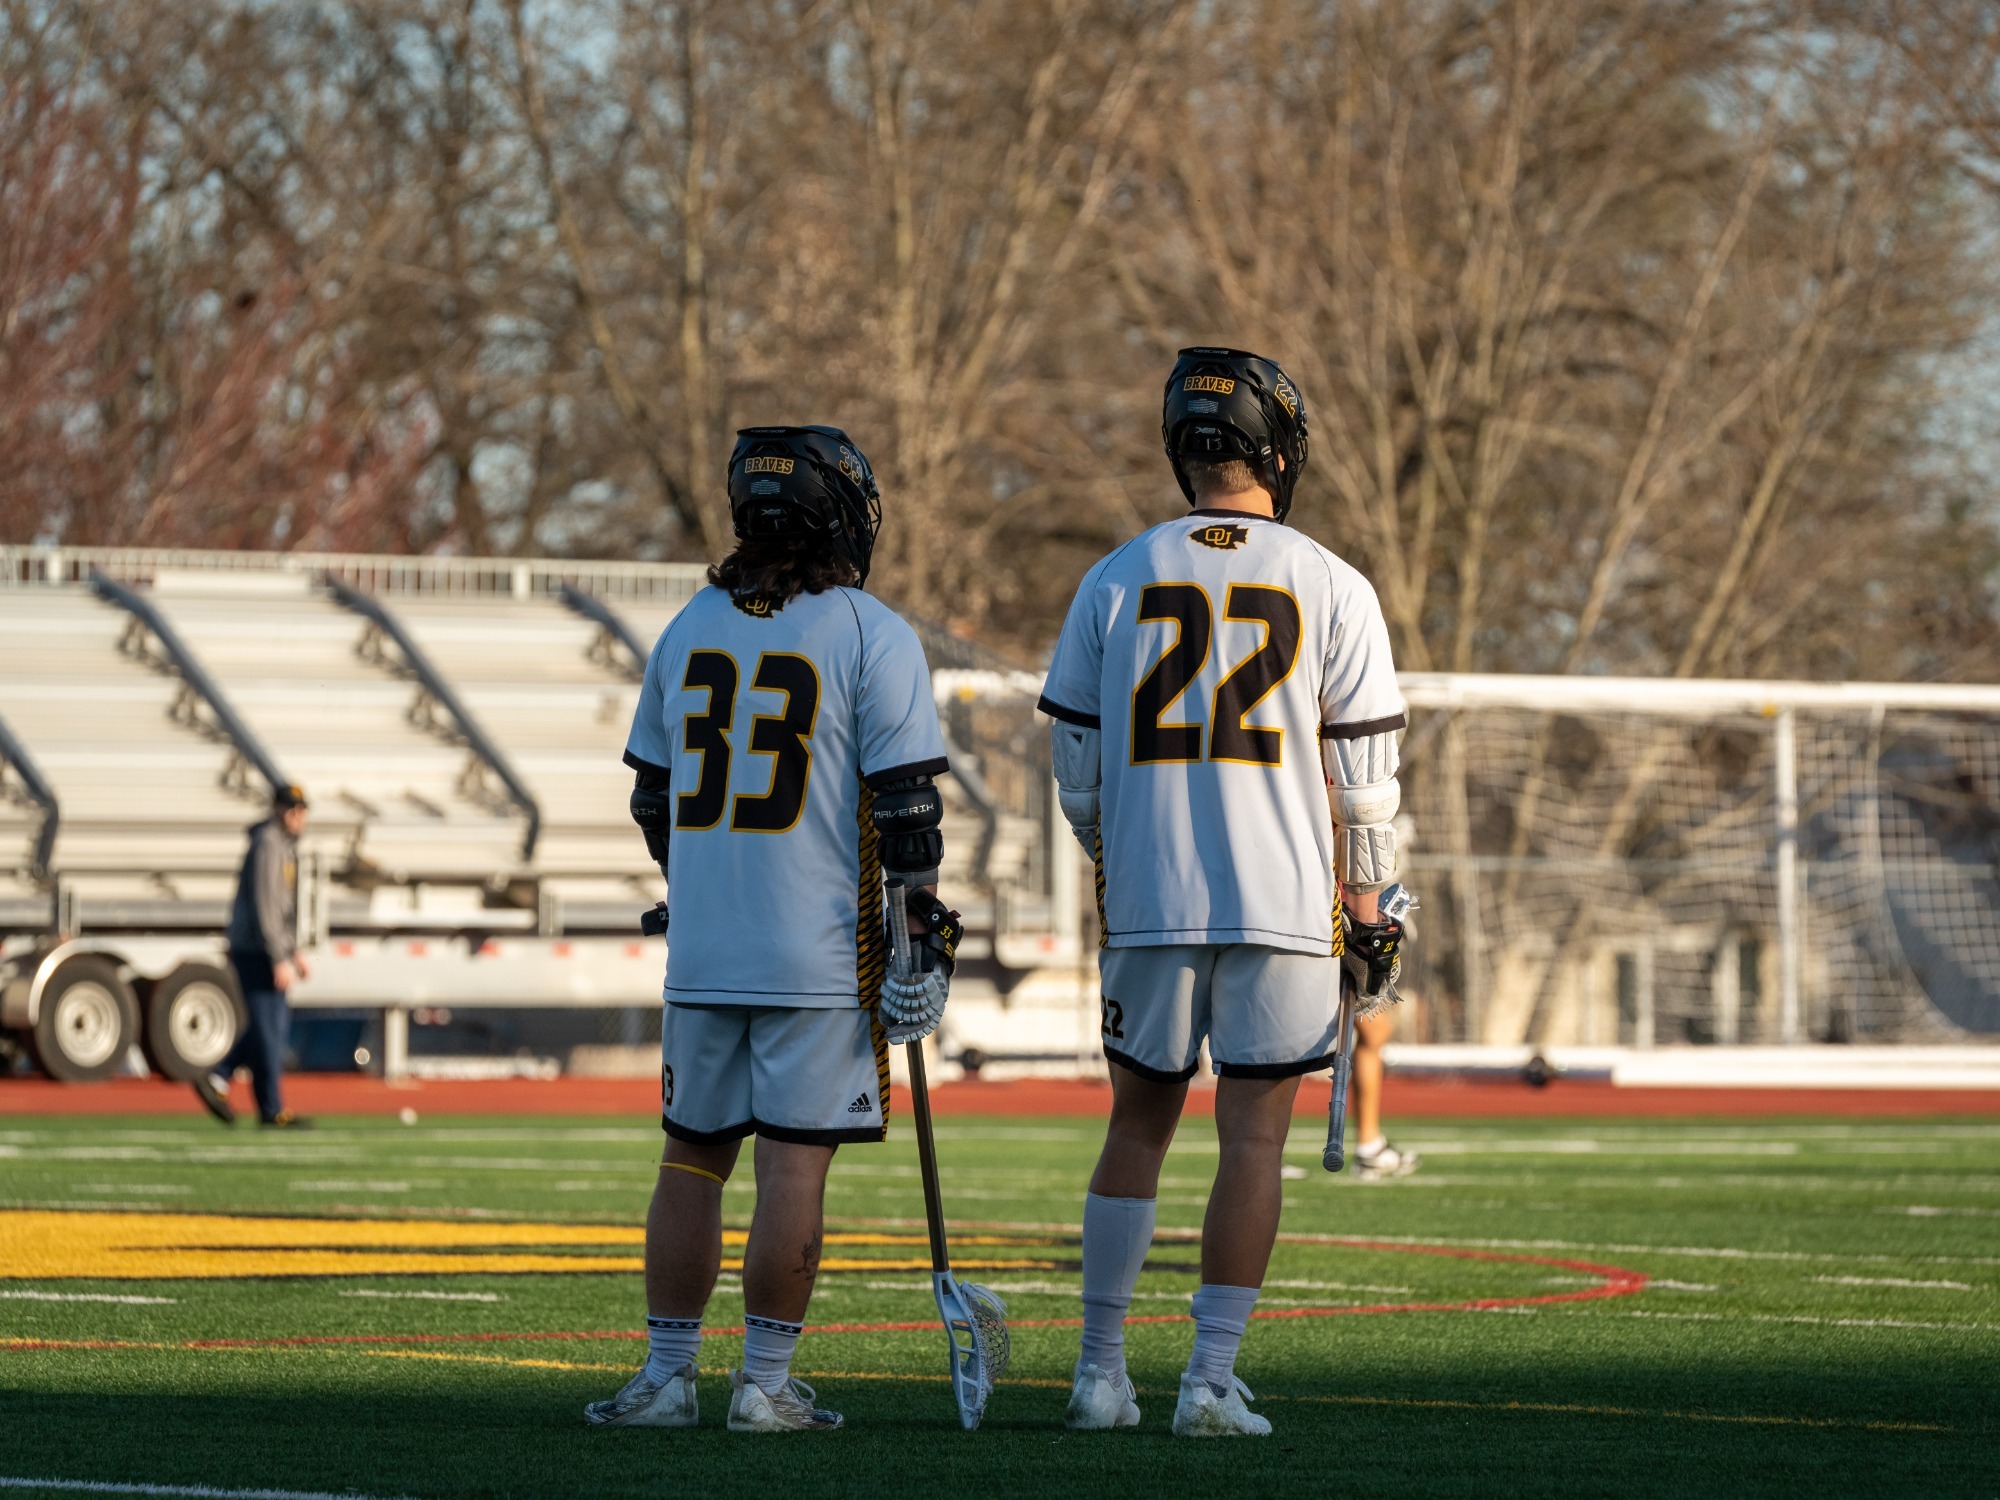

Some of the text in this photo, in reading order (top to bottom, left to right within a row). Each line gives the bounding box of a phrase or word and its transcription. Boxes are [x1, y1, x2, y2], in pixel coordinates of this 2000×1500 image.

[1183, 375, 1234, 395] BRAVES
[1274, 373, 1298, 419] 22
[745, 456, 794, 474] BRAVES
[839, 445, 863, 486] 33
[1129, 581, 1304, 768] 22
[675, 648, 822, 834] 33
[874, 802, 935, 819] MAVERIK
[939, 924, 953, 939] 33
[847, 1105, 873, 1113] adidas
